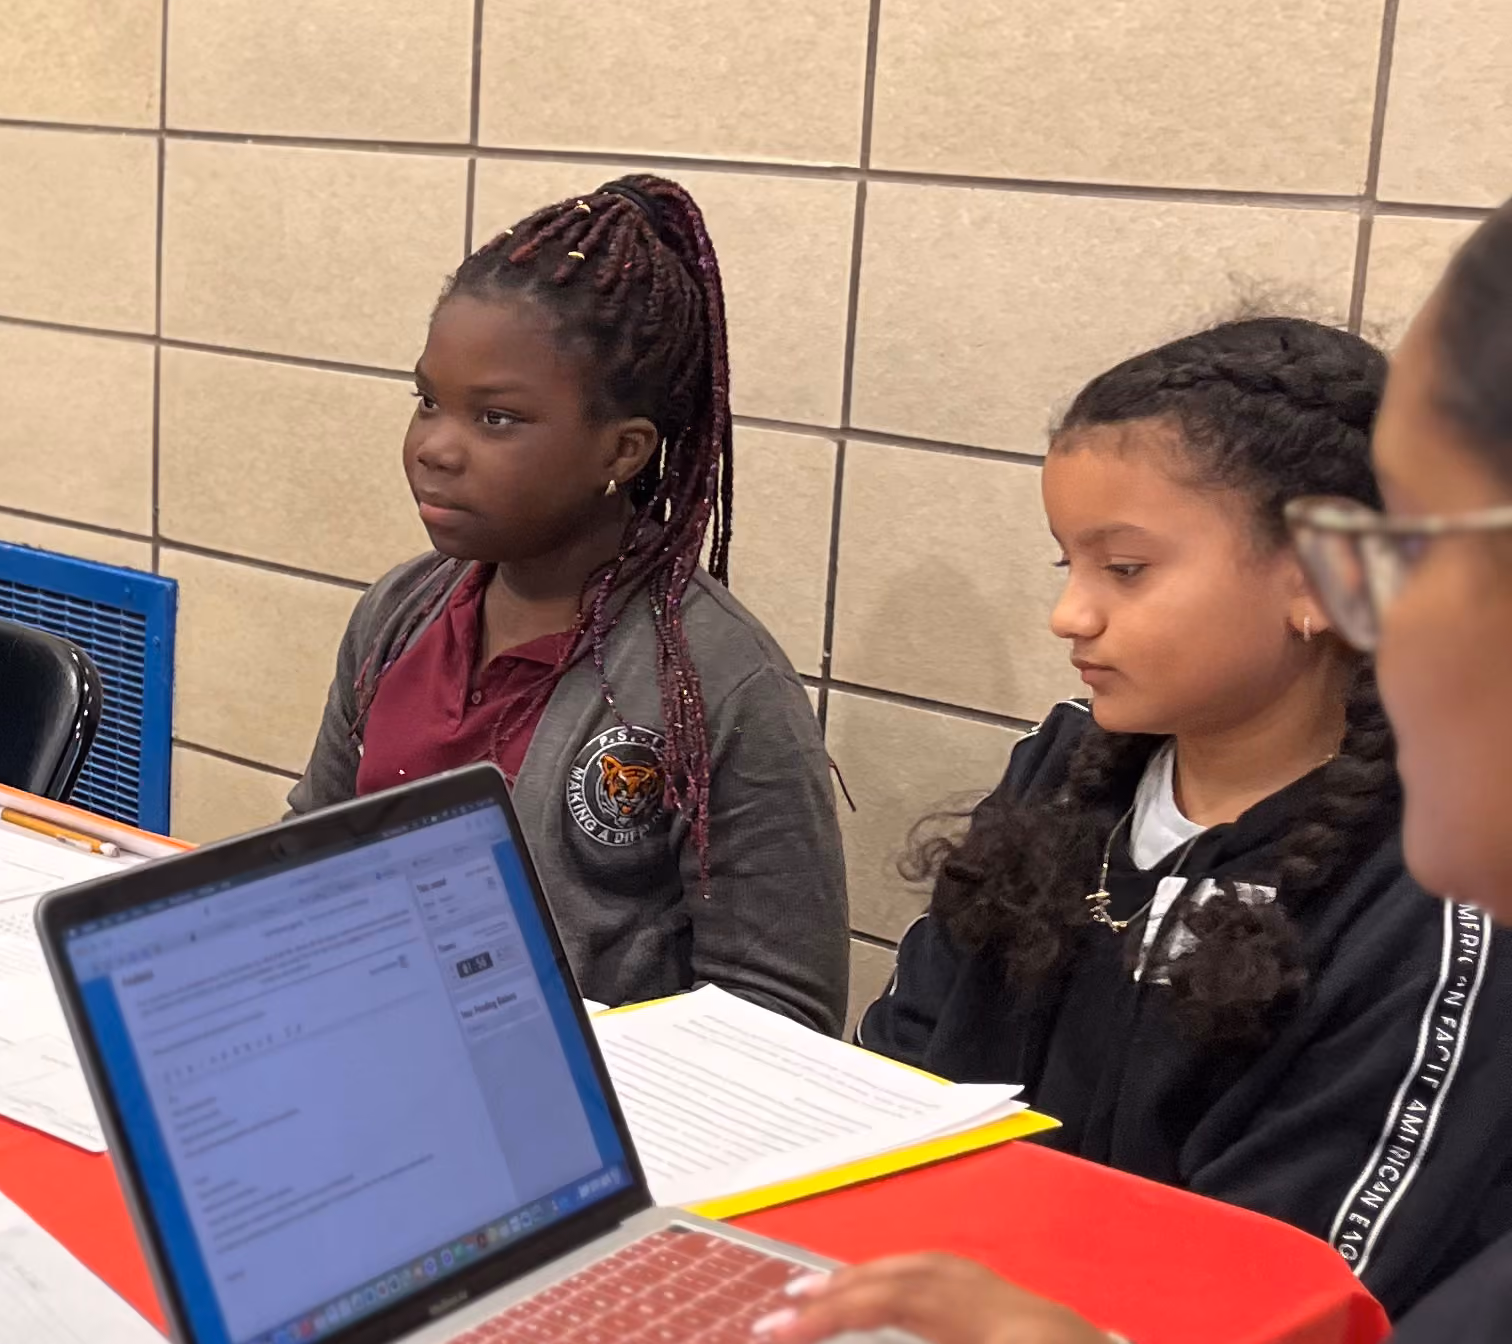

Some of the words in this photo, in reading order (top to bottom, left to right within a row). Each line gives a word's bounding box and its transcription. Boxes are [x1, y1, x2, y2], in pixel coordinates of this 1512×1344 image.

[569, 766, 598, 831] MAKING
[597, 830, 610, 841] A
[1443, 903, 1481, 1007] MERICAN
[1338, 1212, 1372, 1261] EAG
